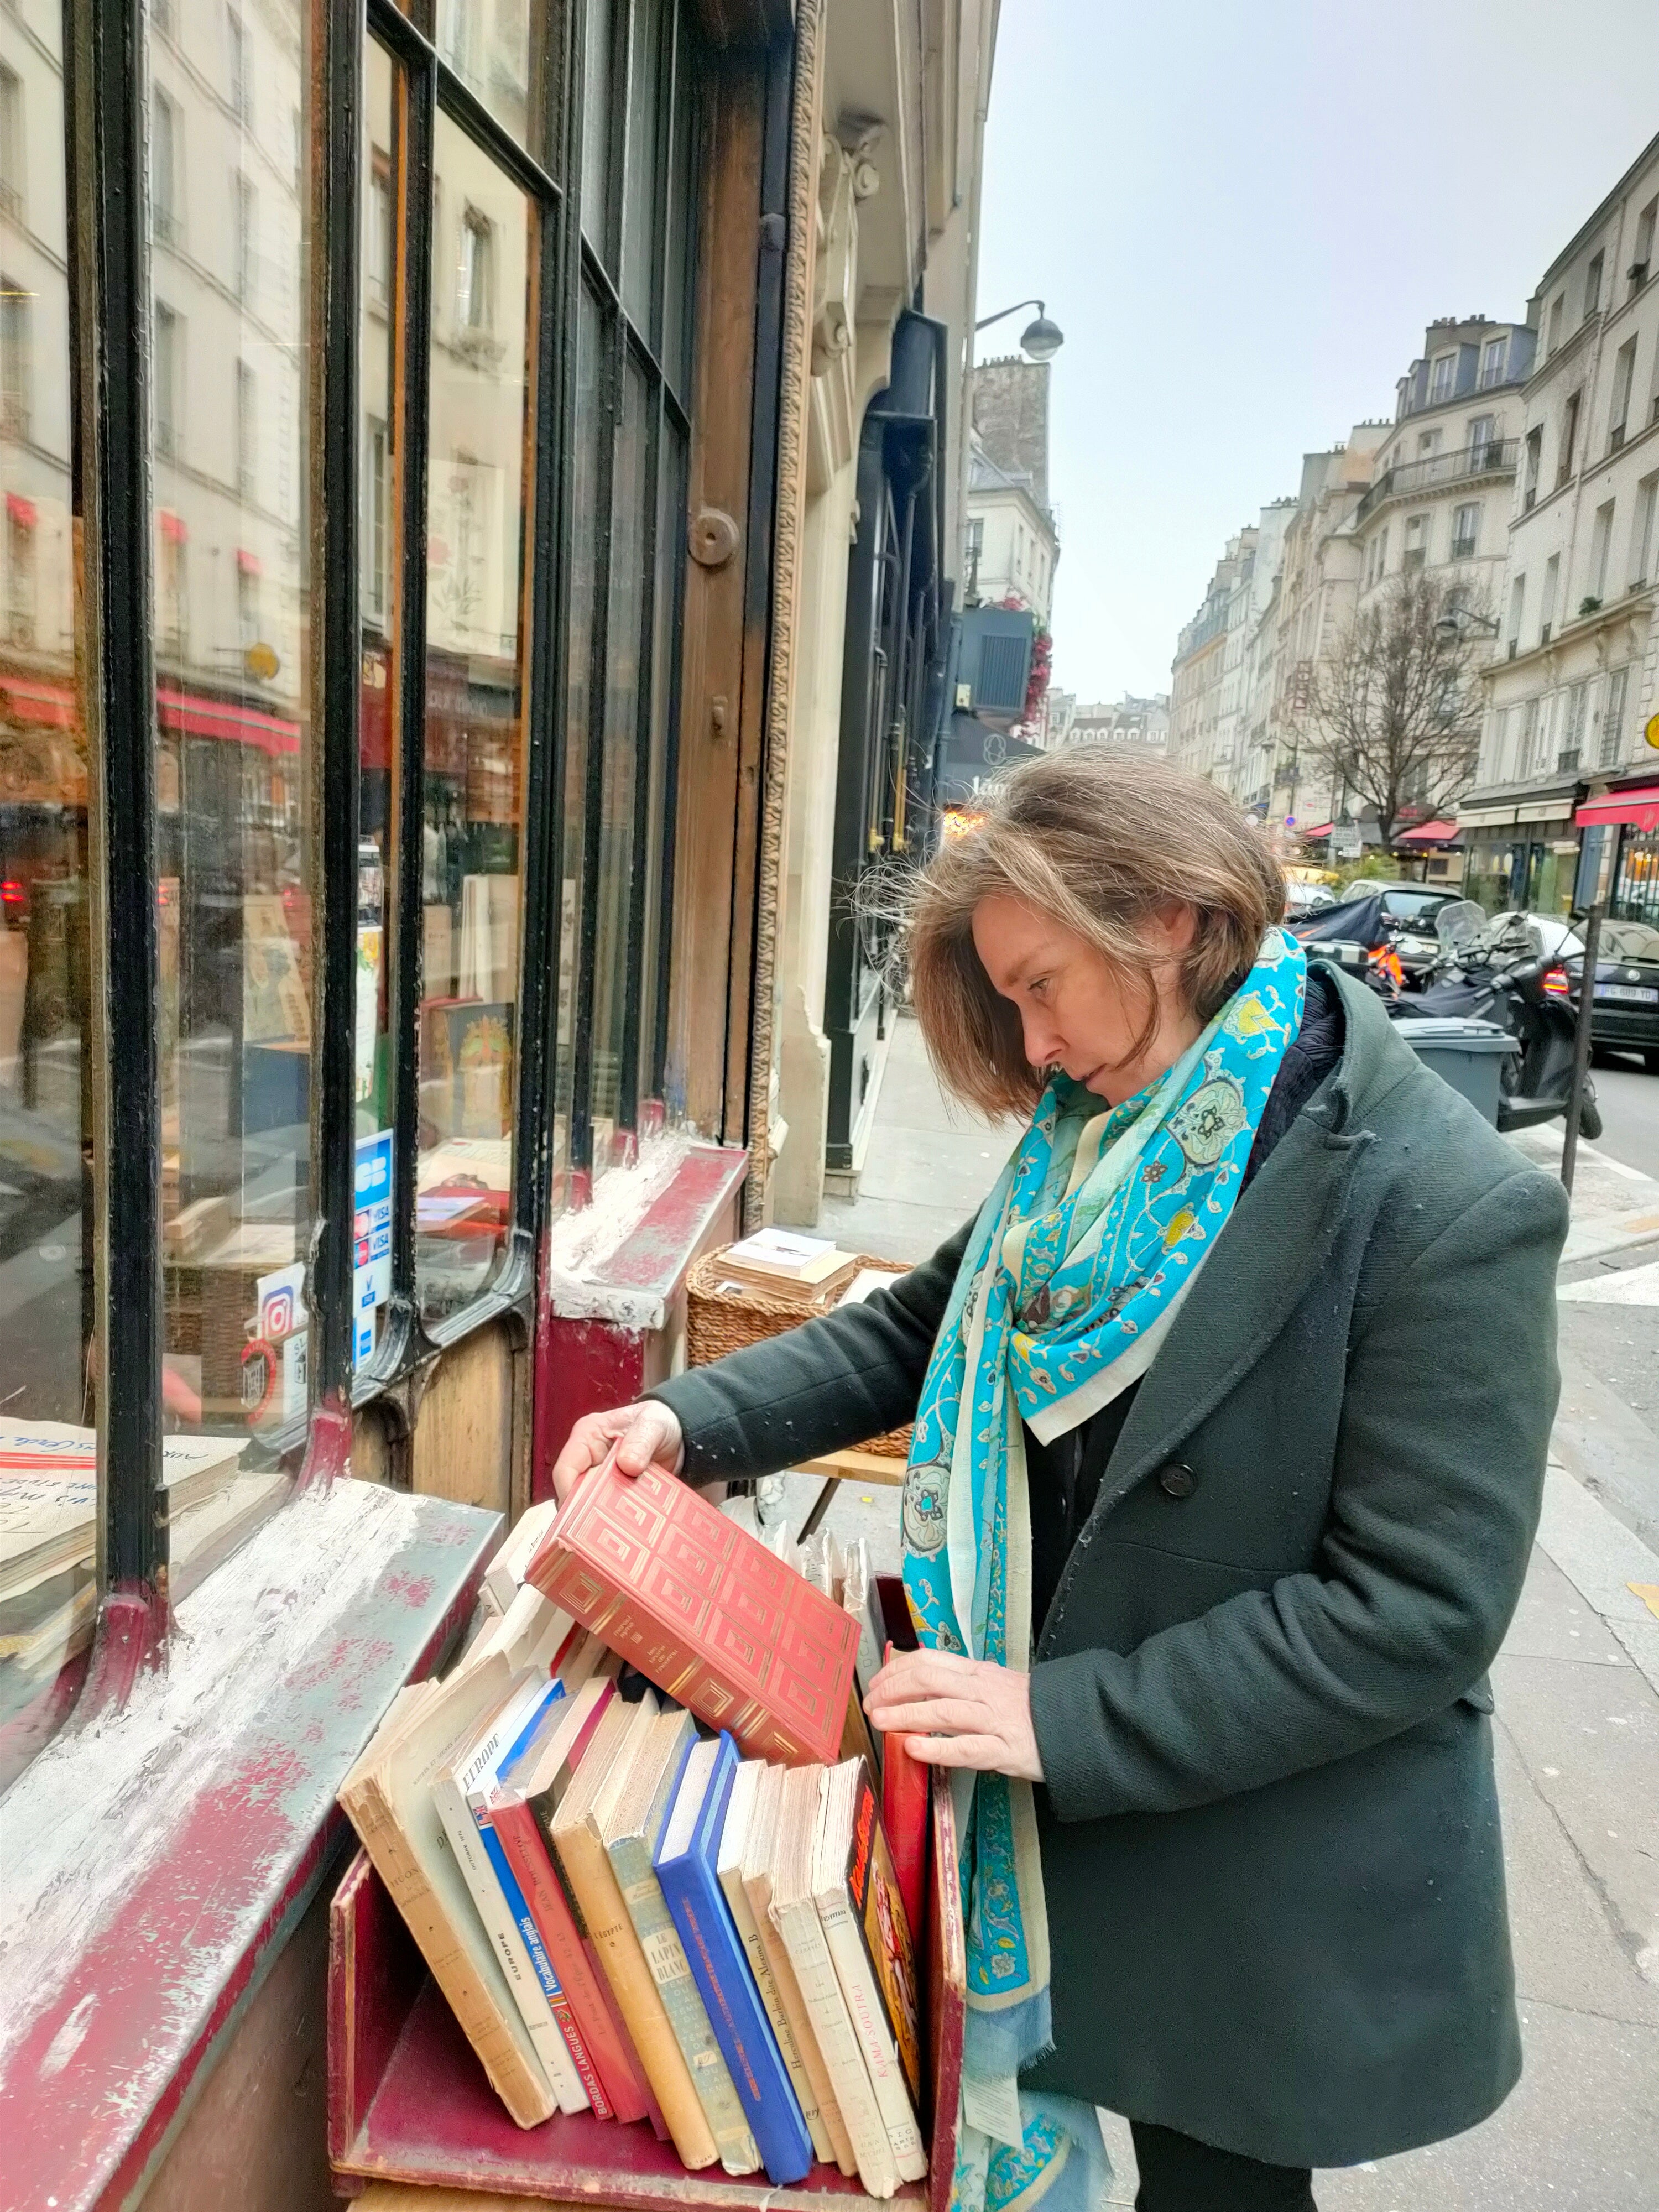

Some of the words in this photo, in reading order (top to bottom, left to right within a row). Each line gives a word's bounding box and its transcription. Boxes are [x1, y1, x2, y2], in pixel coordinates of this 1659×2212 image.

[521, 1917, 540, 1947] anglais
[656, 1934, 667, 1944] LE
[497, 1932, 521, 1981] EUROPE
[651, 1943, 681, 1963] LAPIN
[758, 1945, 773, 1977] Alexina
[531, 1947, 558, 1992] Vocabulaire
[766, 1980, 778, 1996] dite
[773, 1996, 790, 2027] Barbin
[564, 2026, 590, 2072] LANGUES
[783, 2029, 802, 2070] Herculine
[583, 2074, 608, 2115] BORDAS
